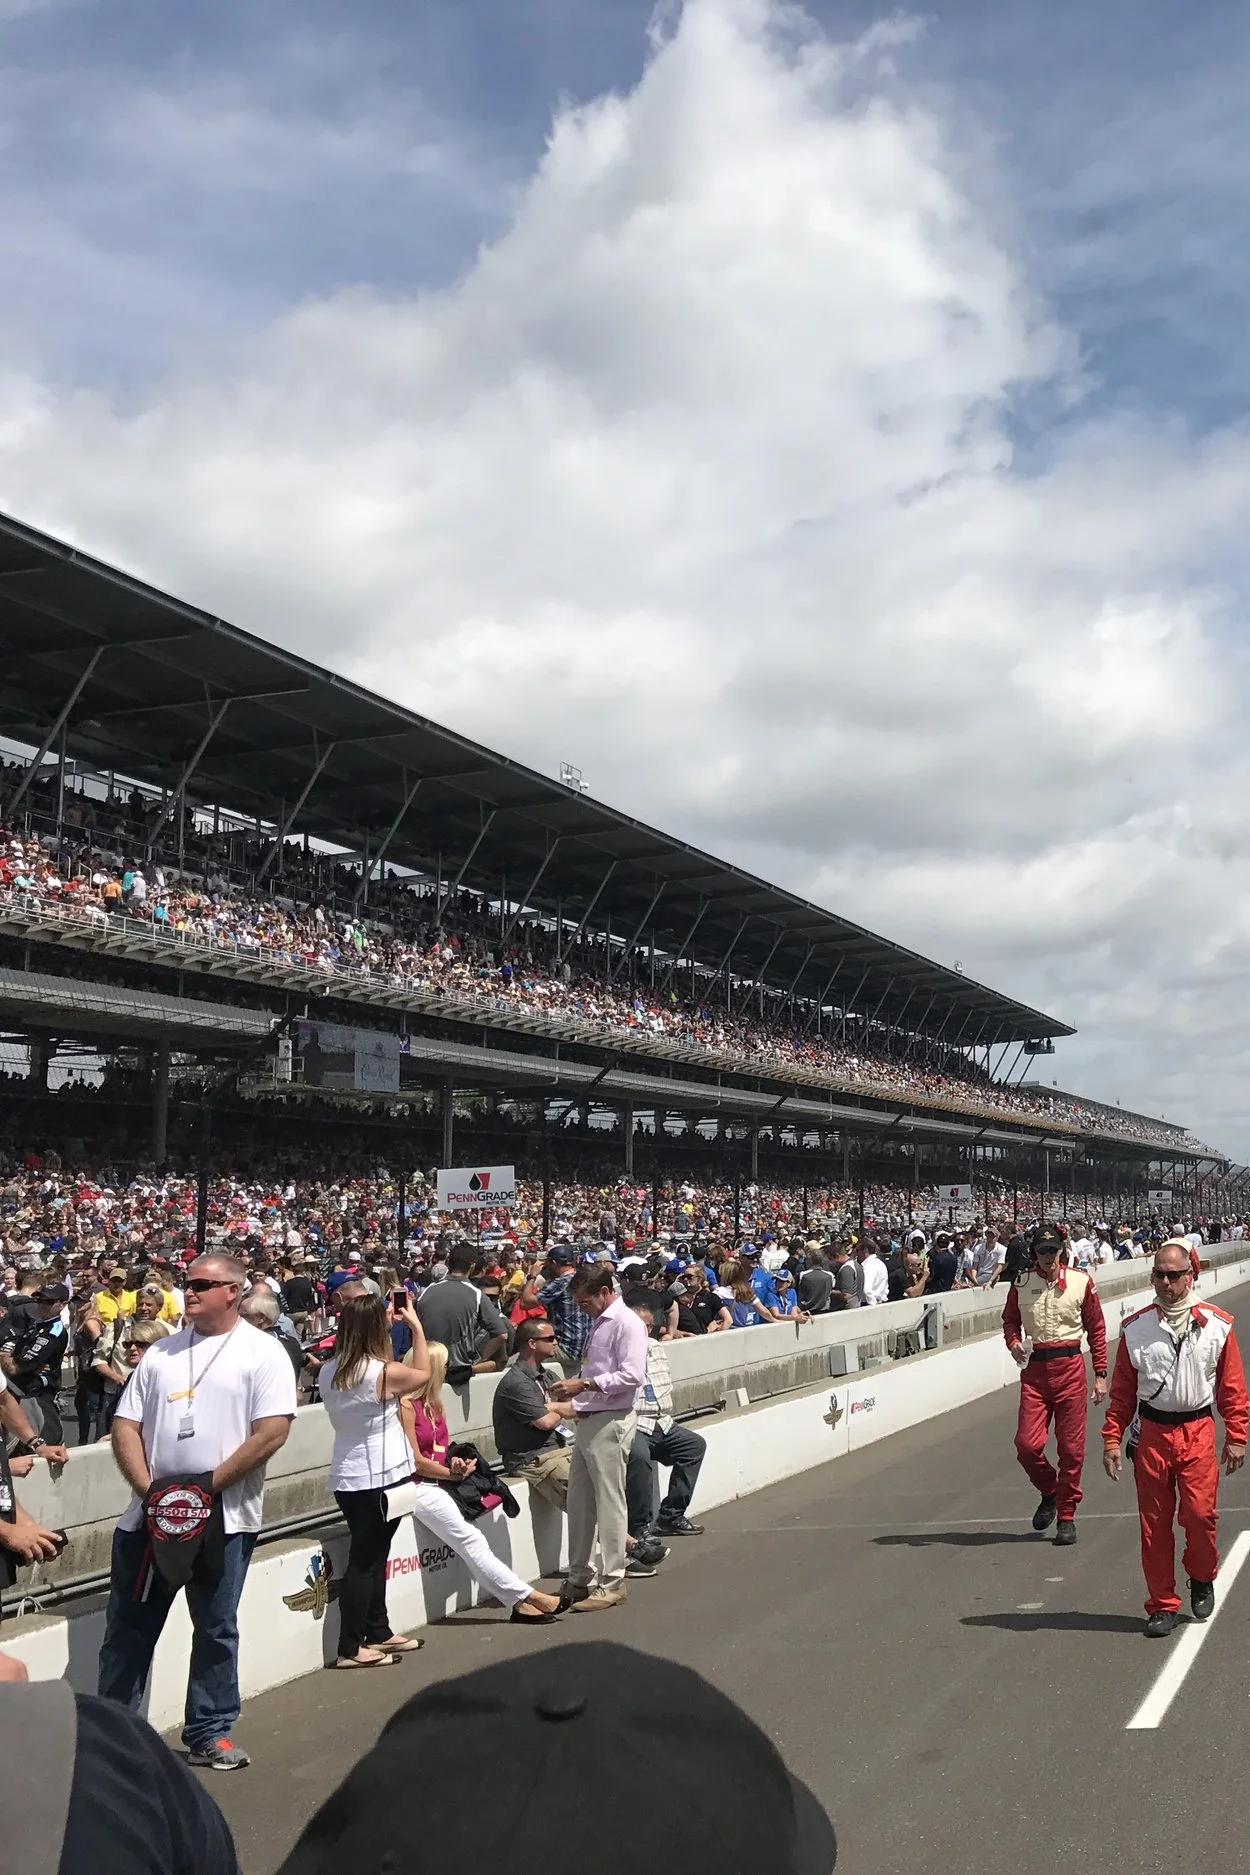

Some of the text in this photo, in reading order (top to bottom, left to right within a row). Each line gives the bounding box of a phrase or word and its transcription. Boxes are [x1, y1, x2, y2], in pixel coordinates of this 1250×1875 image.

[448, 1191, 515, 1203] PENNGRADE
[150, 1507, 208, 1517] WS POSSE
